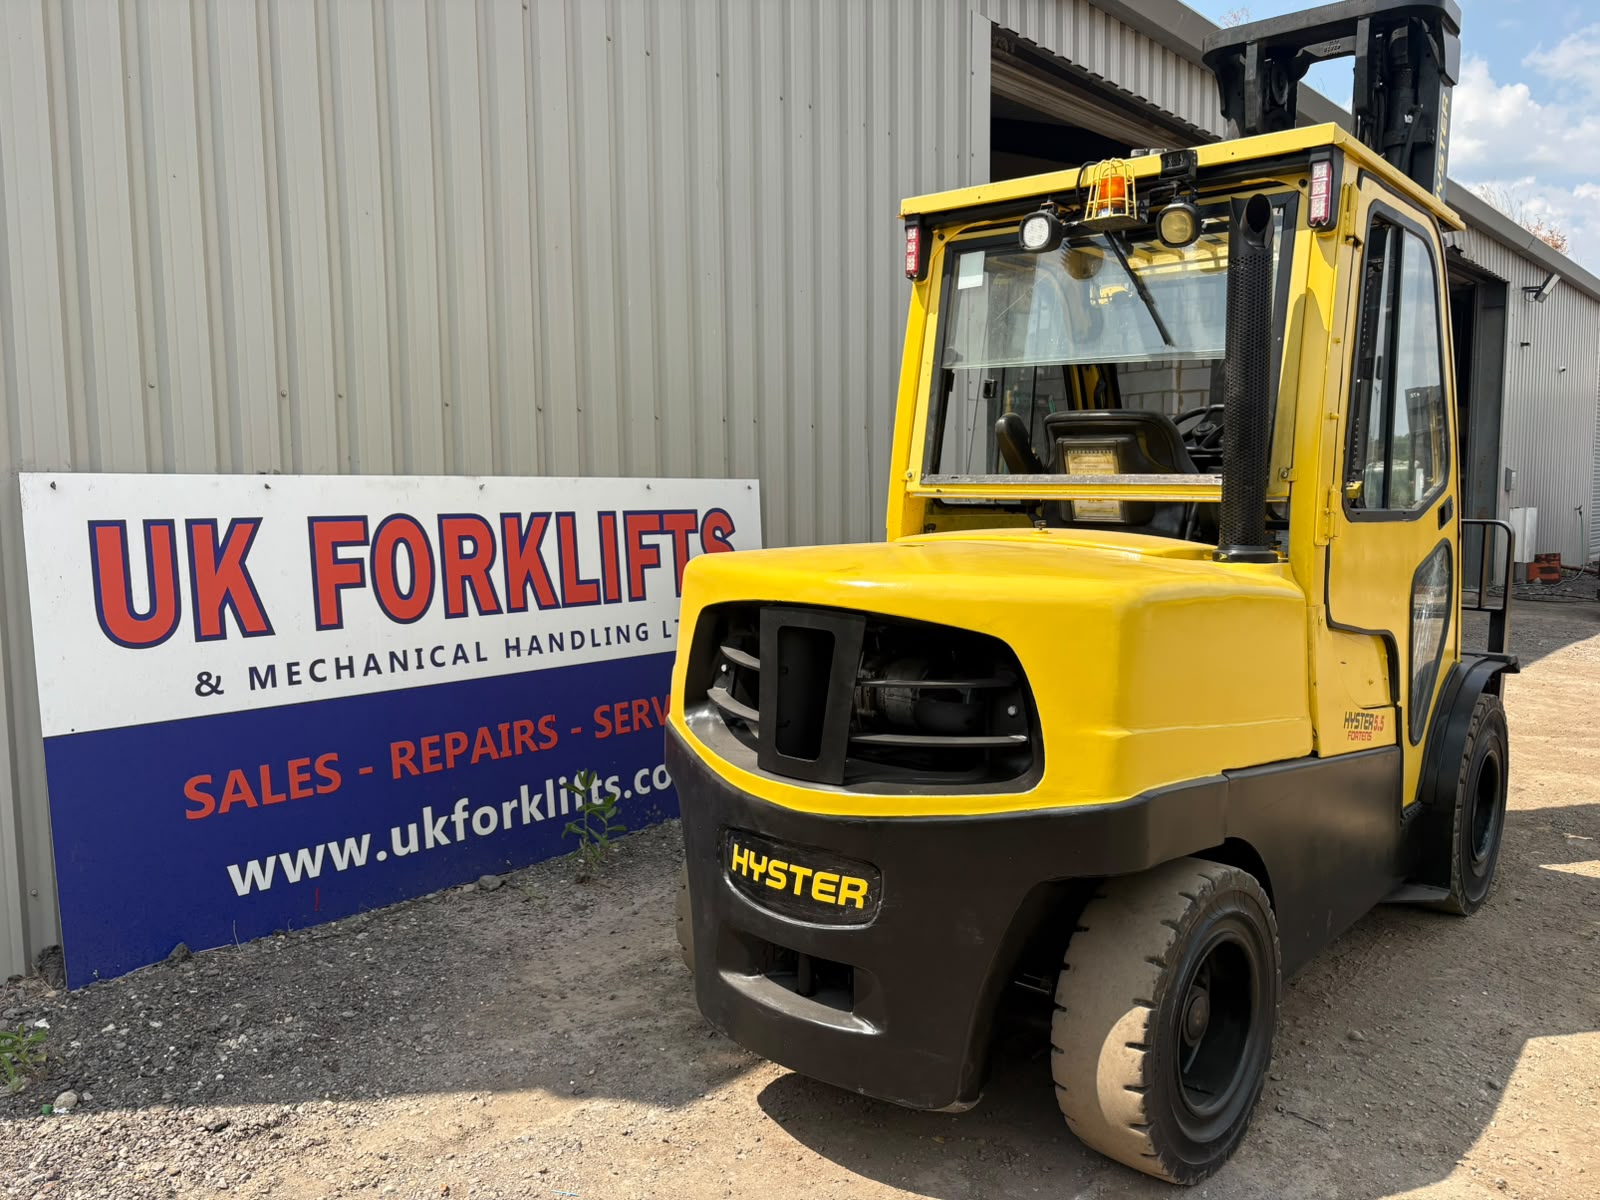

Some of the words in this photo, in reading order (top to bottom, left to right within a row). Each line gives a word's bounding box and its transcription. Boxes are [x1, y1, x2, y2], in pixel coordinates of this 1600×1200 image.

[87, 516, 276, 649] UK
[307, 507, 736, 631] FORKLIFTS
[194, 671, 225, 697] &
[248, 641, 488, 691] MECHANICAL
[504, 622, 649, 660] HANDLING
[662, 618, 680, 639] L
[1343, 711, 1375, 731] HYSTER
[183, 752, 342, 820] SALES
[358, 766, 373, 775] -
[390, 714, 559, 780] REPAIRS
[570, 726, 582, 735] -
[731, 843, 869, 909] HYSTER
